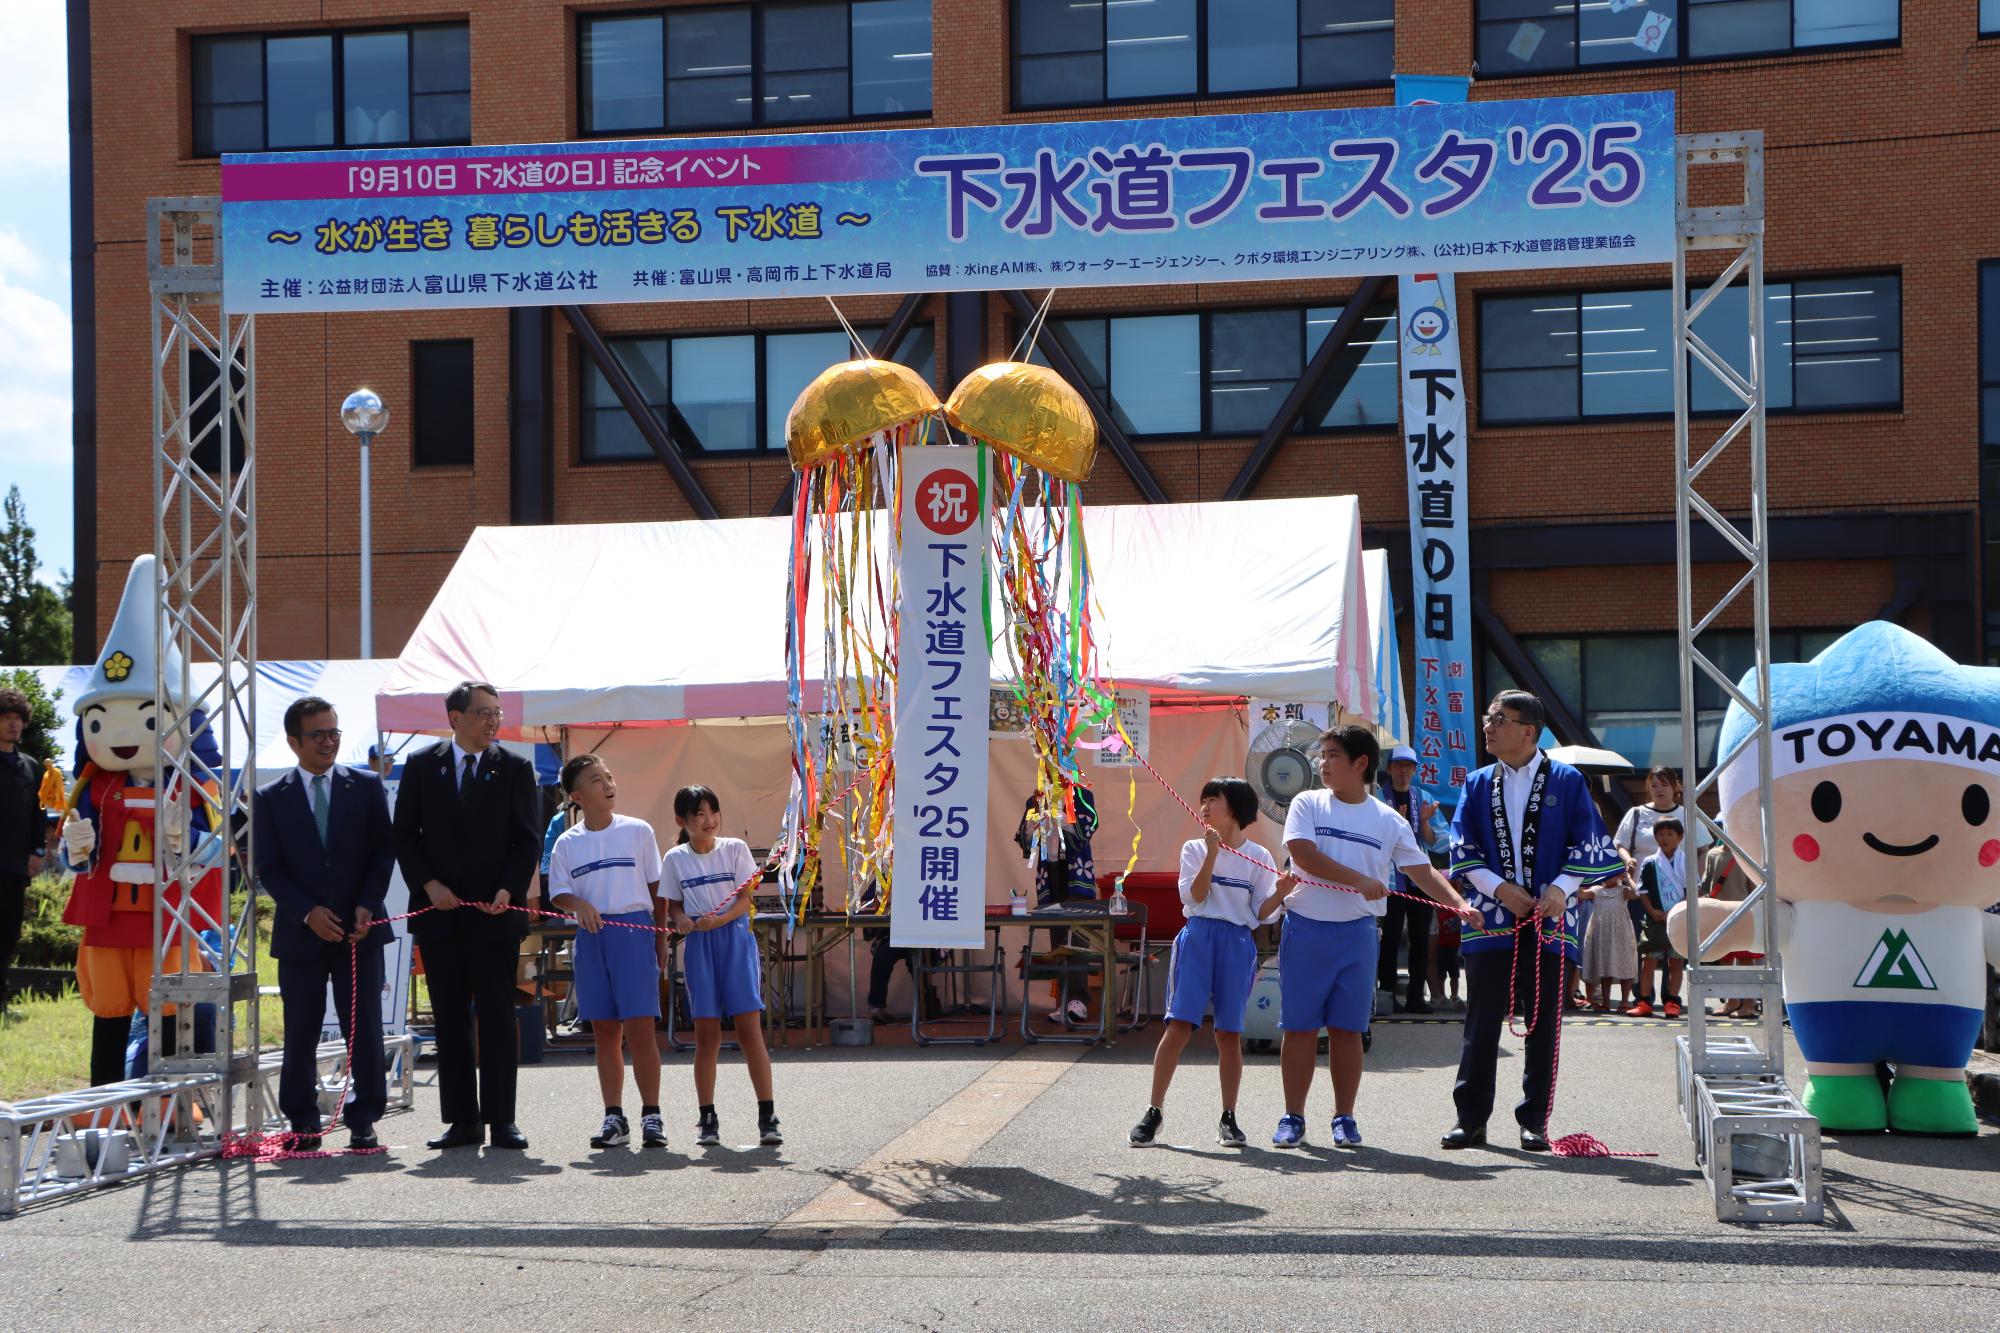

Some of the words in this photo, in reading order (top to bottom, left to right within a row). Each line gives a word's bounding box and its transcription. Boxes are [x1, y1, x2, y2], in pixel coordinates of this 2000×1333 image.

[348, 164, 456, 192] 「9月10日
[915, 123, 1645, 239] 下水道フェスタ'25
[315, 215, 452, 255] 水が生き
[466, 207, 702, 251] 暮らしも活きる
[716, 202, 823, 242] 下水道
[927, 481, 968, 523] 祝
[1409, 369, 1457, 641] 下水道の日
[1782, 718, 2000, 764] TOYAMA
